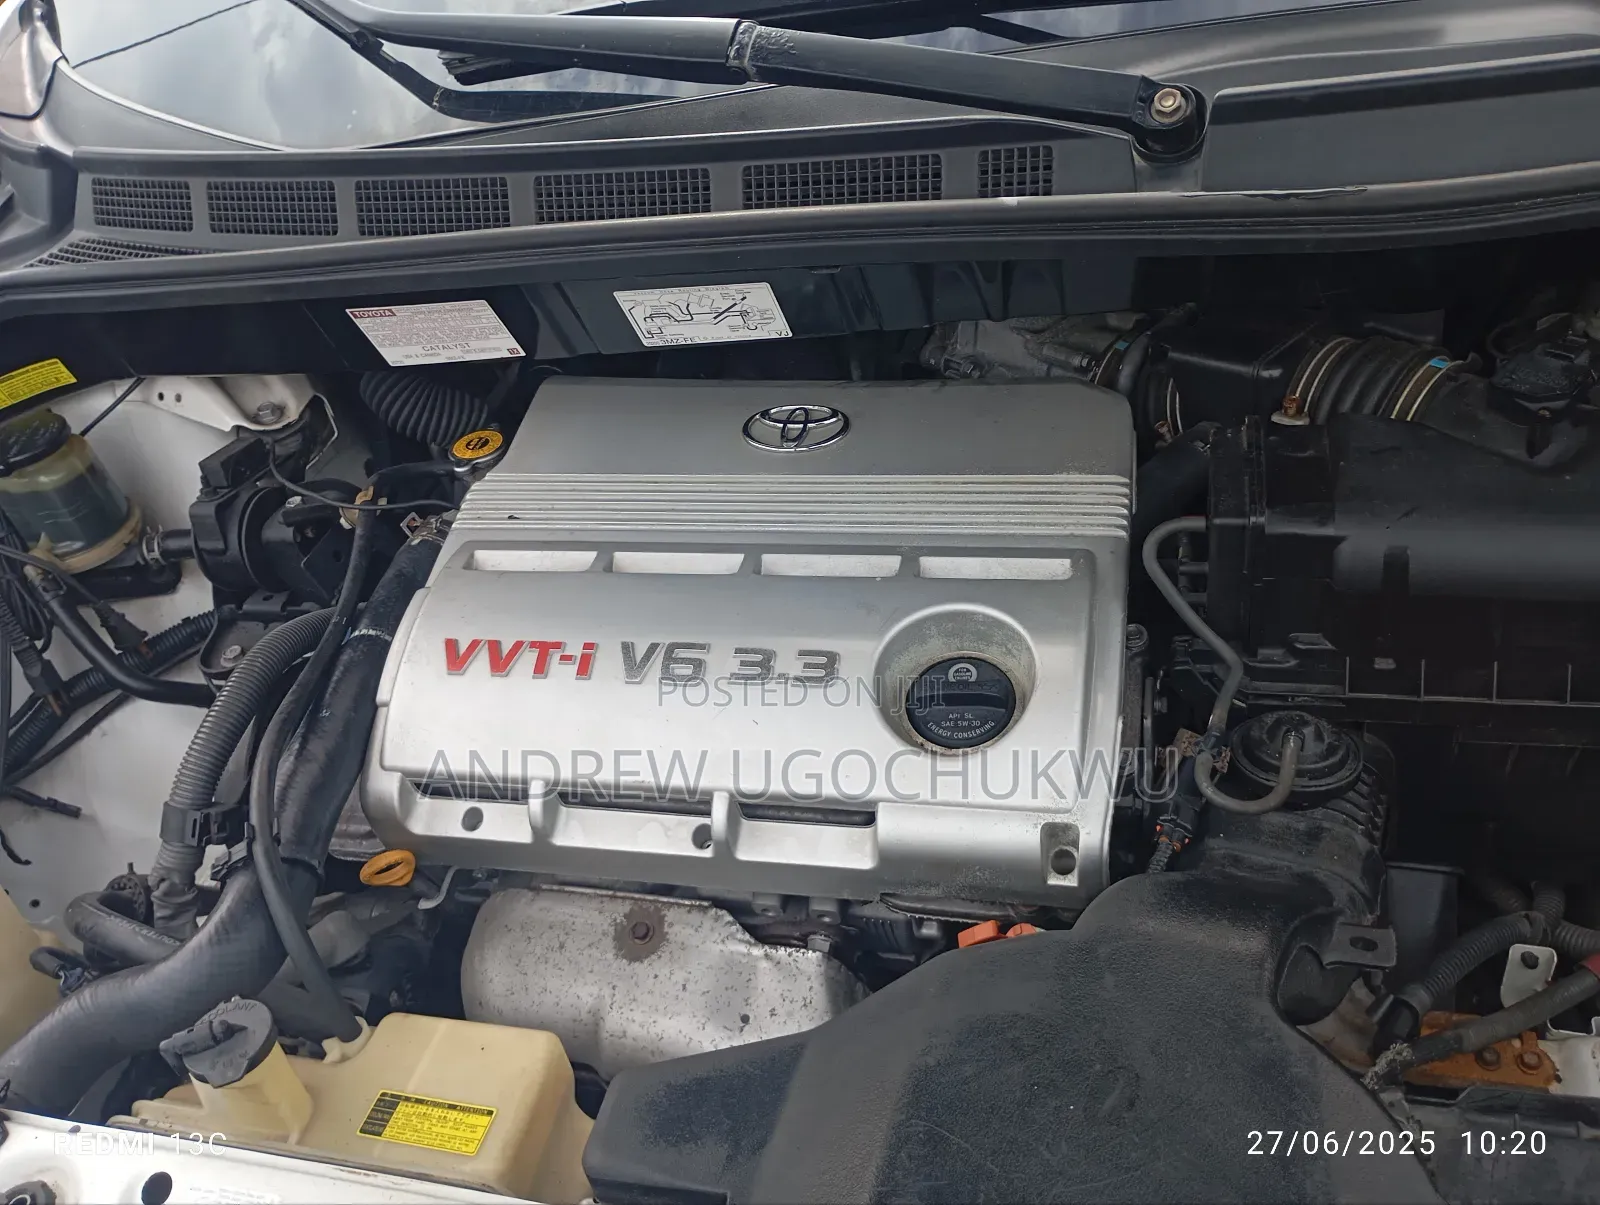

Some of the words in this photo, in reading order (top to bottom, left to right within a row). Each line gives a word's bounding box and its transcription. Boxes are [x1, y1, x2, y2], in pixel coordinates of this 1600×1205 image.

[353, 310, 392, 319] TOYOTA
[660, 336, 697, 345] 3MZ-FE
[421, 342, 471, 352] CATALYST
[444, 637, 599, 680] VVT-i
[620, 641, 710, 686] V6
[729, 647, 842, 688] 3.3
[927, 721, 951, 738] ENERGY
[953, 720, 995, 739] CONSERVING
